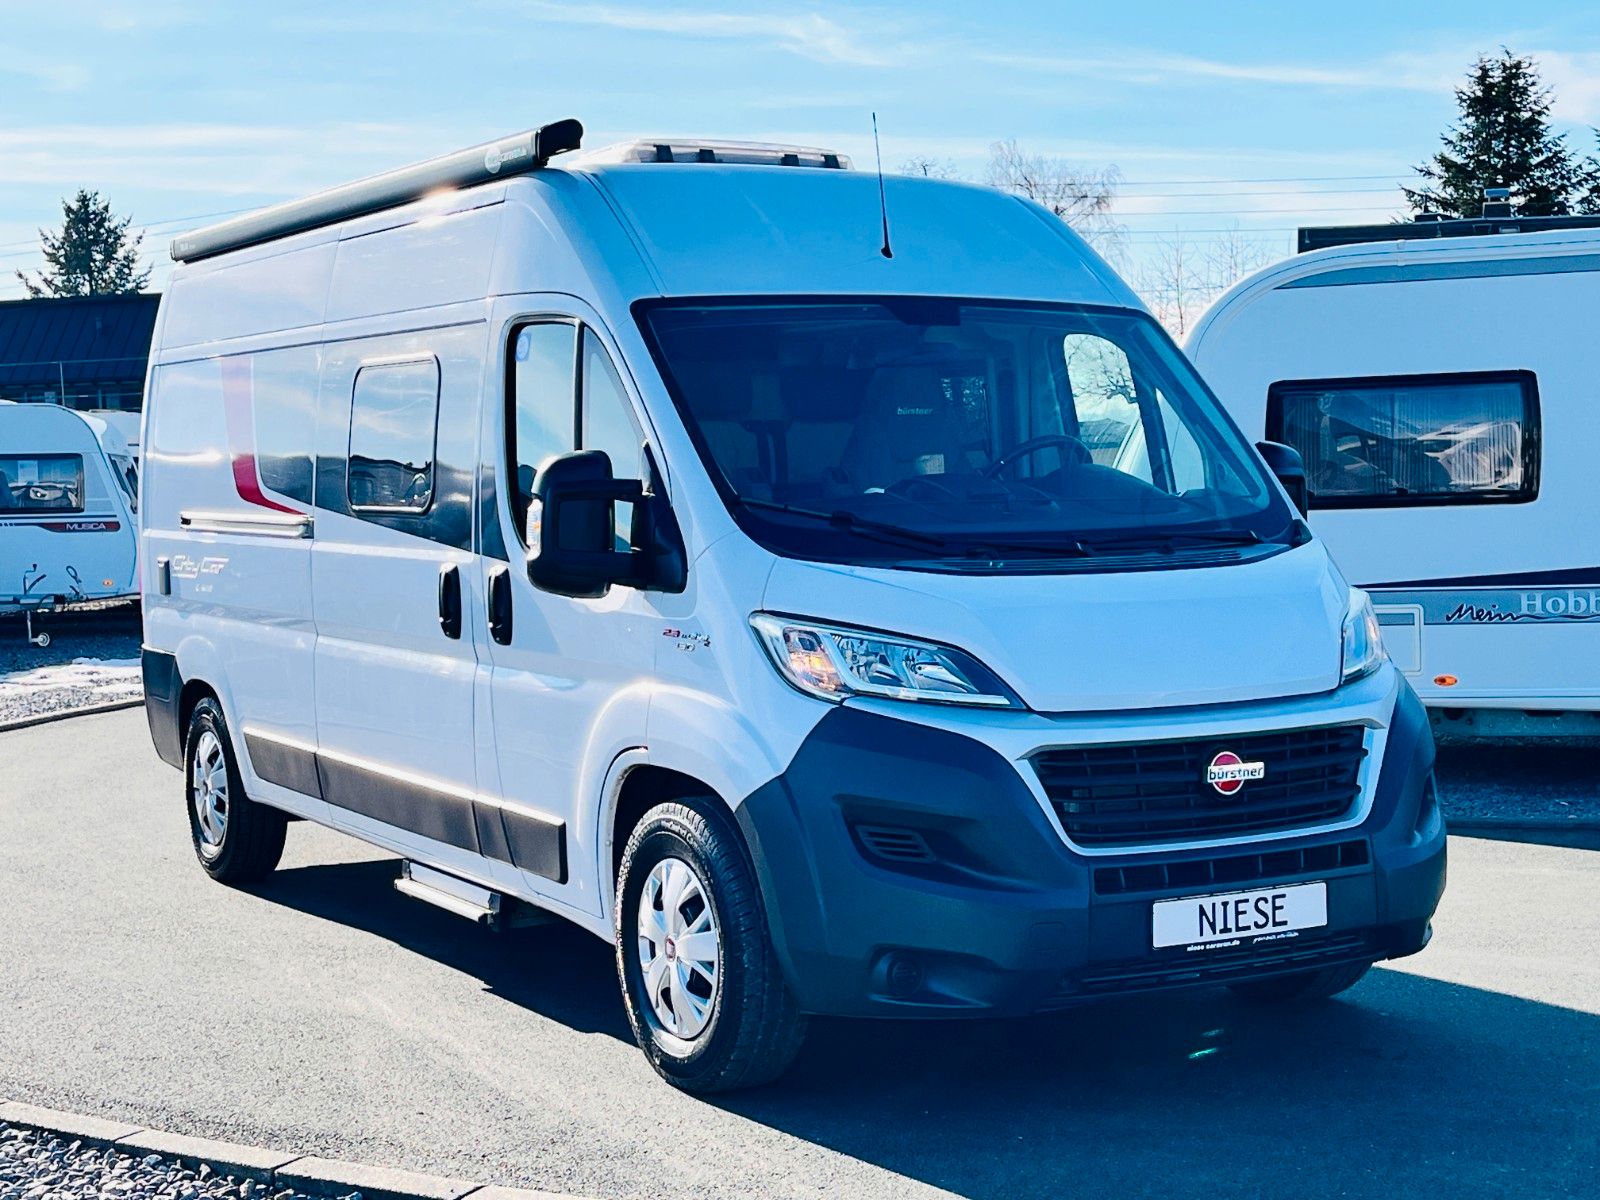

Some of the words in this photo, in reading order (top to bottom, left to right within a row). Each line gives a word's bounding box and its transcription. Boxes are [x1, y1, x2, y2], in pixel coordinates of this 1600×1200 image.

[1446, 602, 1519, 622] Mein
[1209, 767, 1264, 781] bürstner
[1198, 893, 1289, 937] NIESE
